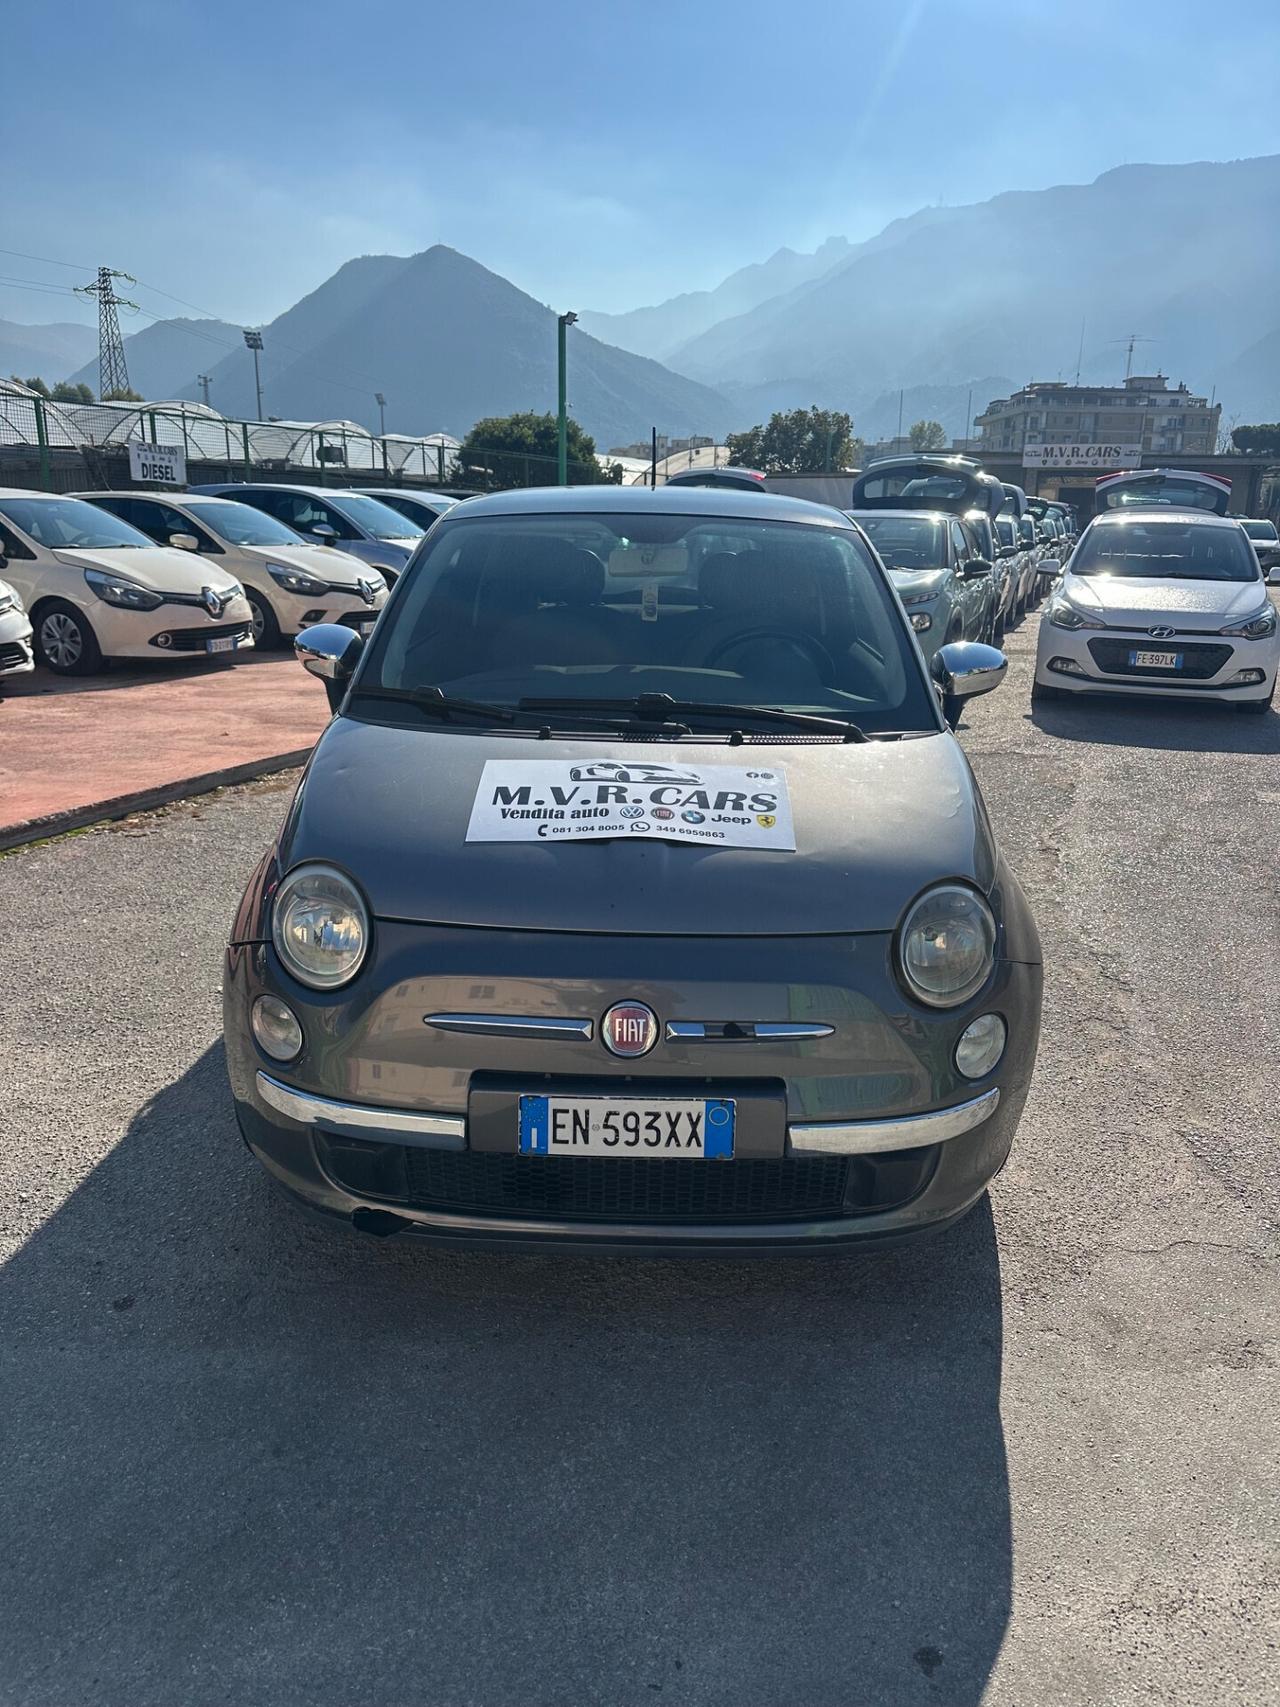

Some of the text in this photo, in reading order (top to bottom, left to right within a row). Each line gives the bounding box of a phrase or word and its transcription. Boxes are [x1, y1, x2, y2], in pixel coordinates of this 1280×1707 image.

[141, 462, 177, 482] DIESEL
[500, 806, 610, 820] Vendita auto
[711, 814, 752, 826] Jeep
[552, 824, 625, 834] 081 304 8005
[656, 824, 726, 839] 349 6959863
[615, 1018, 646, 1043] FIAT
